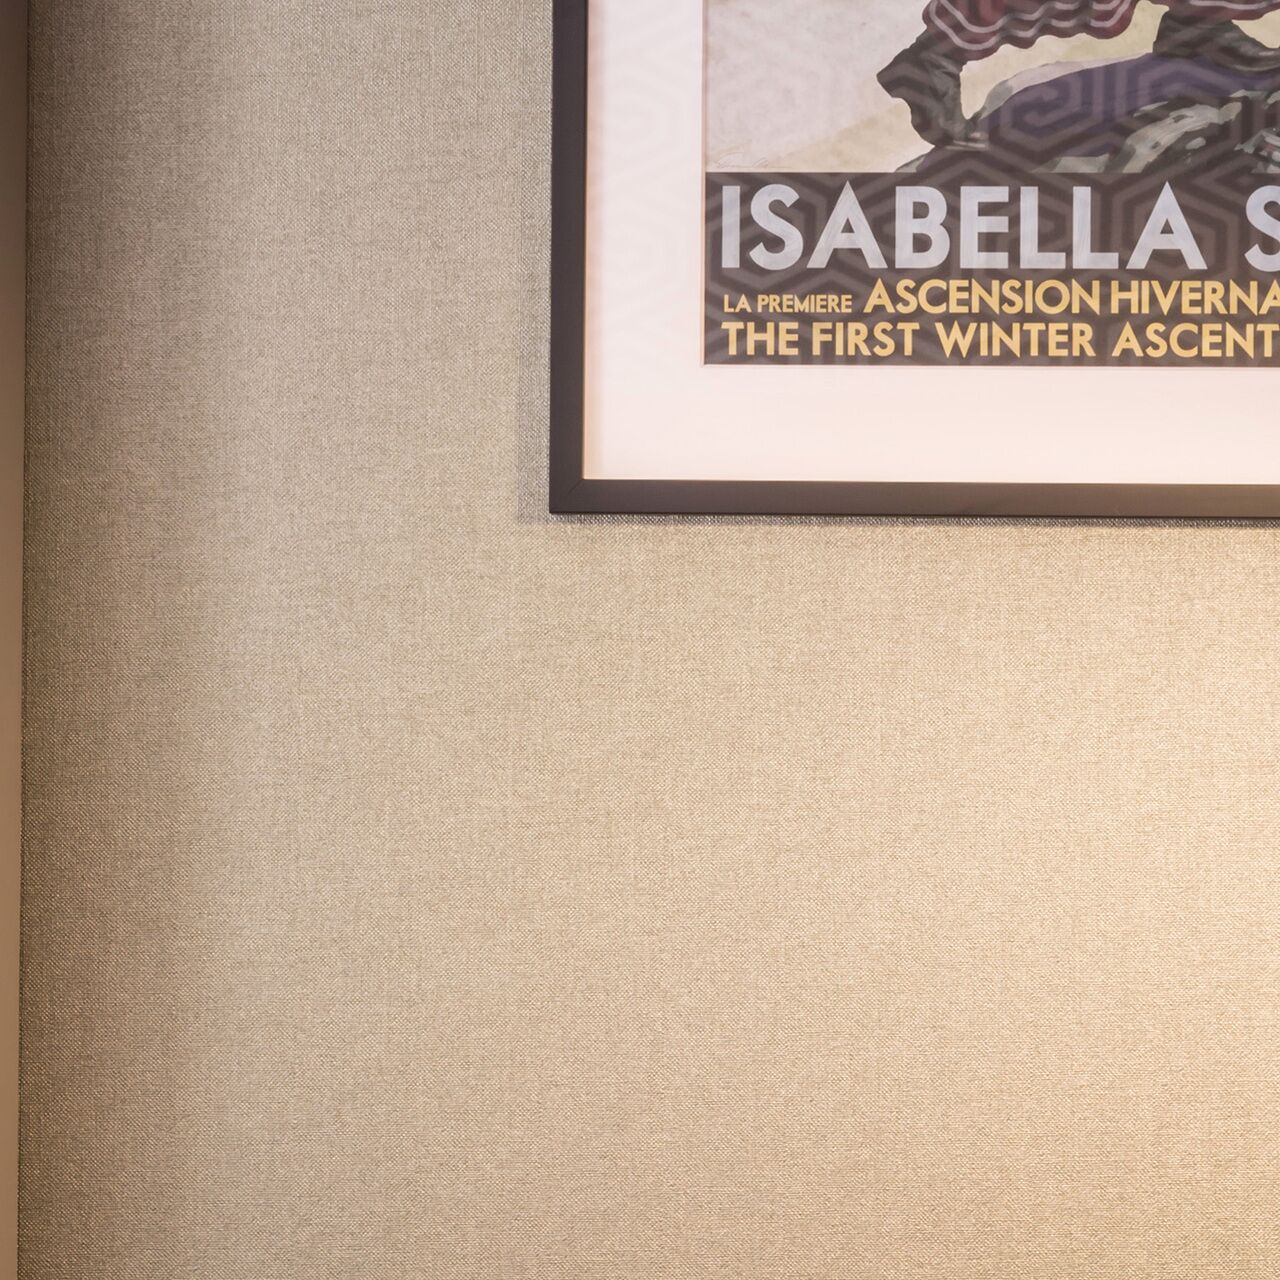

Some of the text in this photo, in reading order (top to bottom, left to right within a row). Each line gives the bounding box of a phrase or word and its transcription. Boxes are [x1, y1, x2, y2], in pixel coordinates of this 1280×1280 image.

[721, 180, 1208, 271] ISABELLA
[723, 294, 750, 314] LA
[757, 294, 853, 314] PREMIERE
[863, 277, 1100, 316] ASCENSION
[721, 321, 799, 358] THE
[812, 320, 920, 358] FIRST
[934, 320, 1097, 359] WINTER
[1111, 320, 1280, 360] ASCENT
